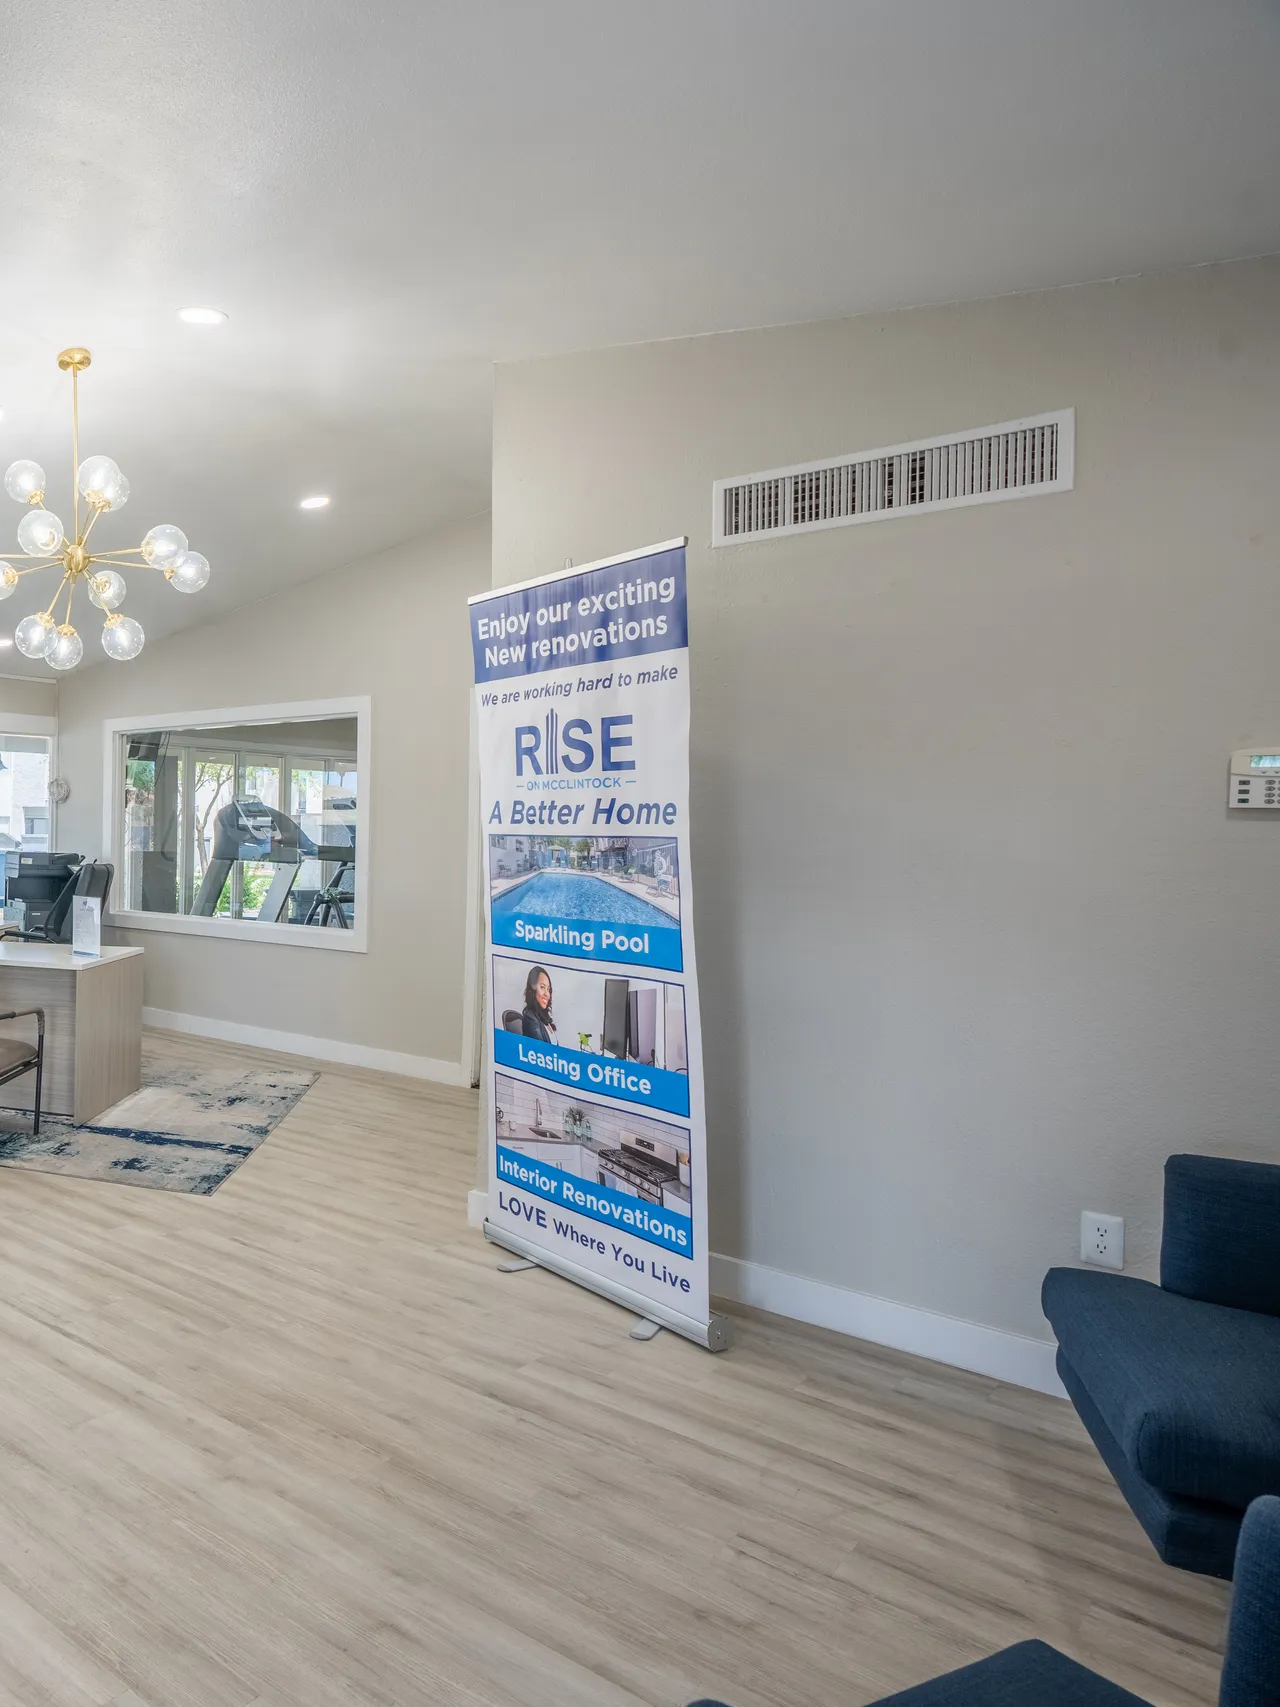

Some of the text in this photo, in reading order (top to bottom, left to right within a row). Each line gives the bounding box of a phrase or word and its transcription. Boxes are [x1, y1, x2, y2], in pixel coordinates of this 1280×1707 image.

[477, 576, 676, 641] Enjoy our exciting
[484, 614, 668, 669] New renovations
[481, 664, 678, 707] We are working hard to make
[514, 707, 636, 777] RISE
[526, 776, 622, 791] ON MCCLINTOCK
[488, 797, 677, 825] A Better Home
[515, 919, 649, 953] Sparkling Pool
[518, 1043, 652, 1095] Leasing Office
[499, 1155, 688, 1247] Interior Renovations
[499, 1191, 691, 1293] LOVE Where You Live
